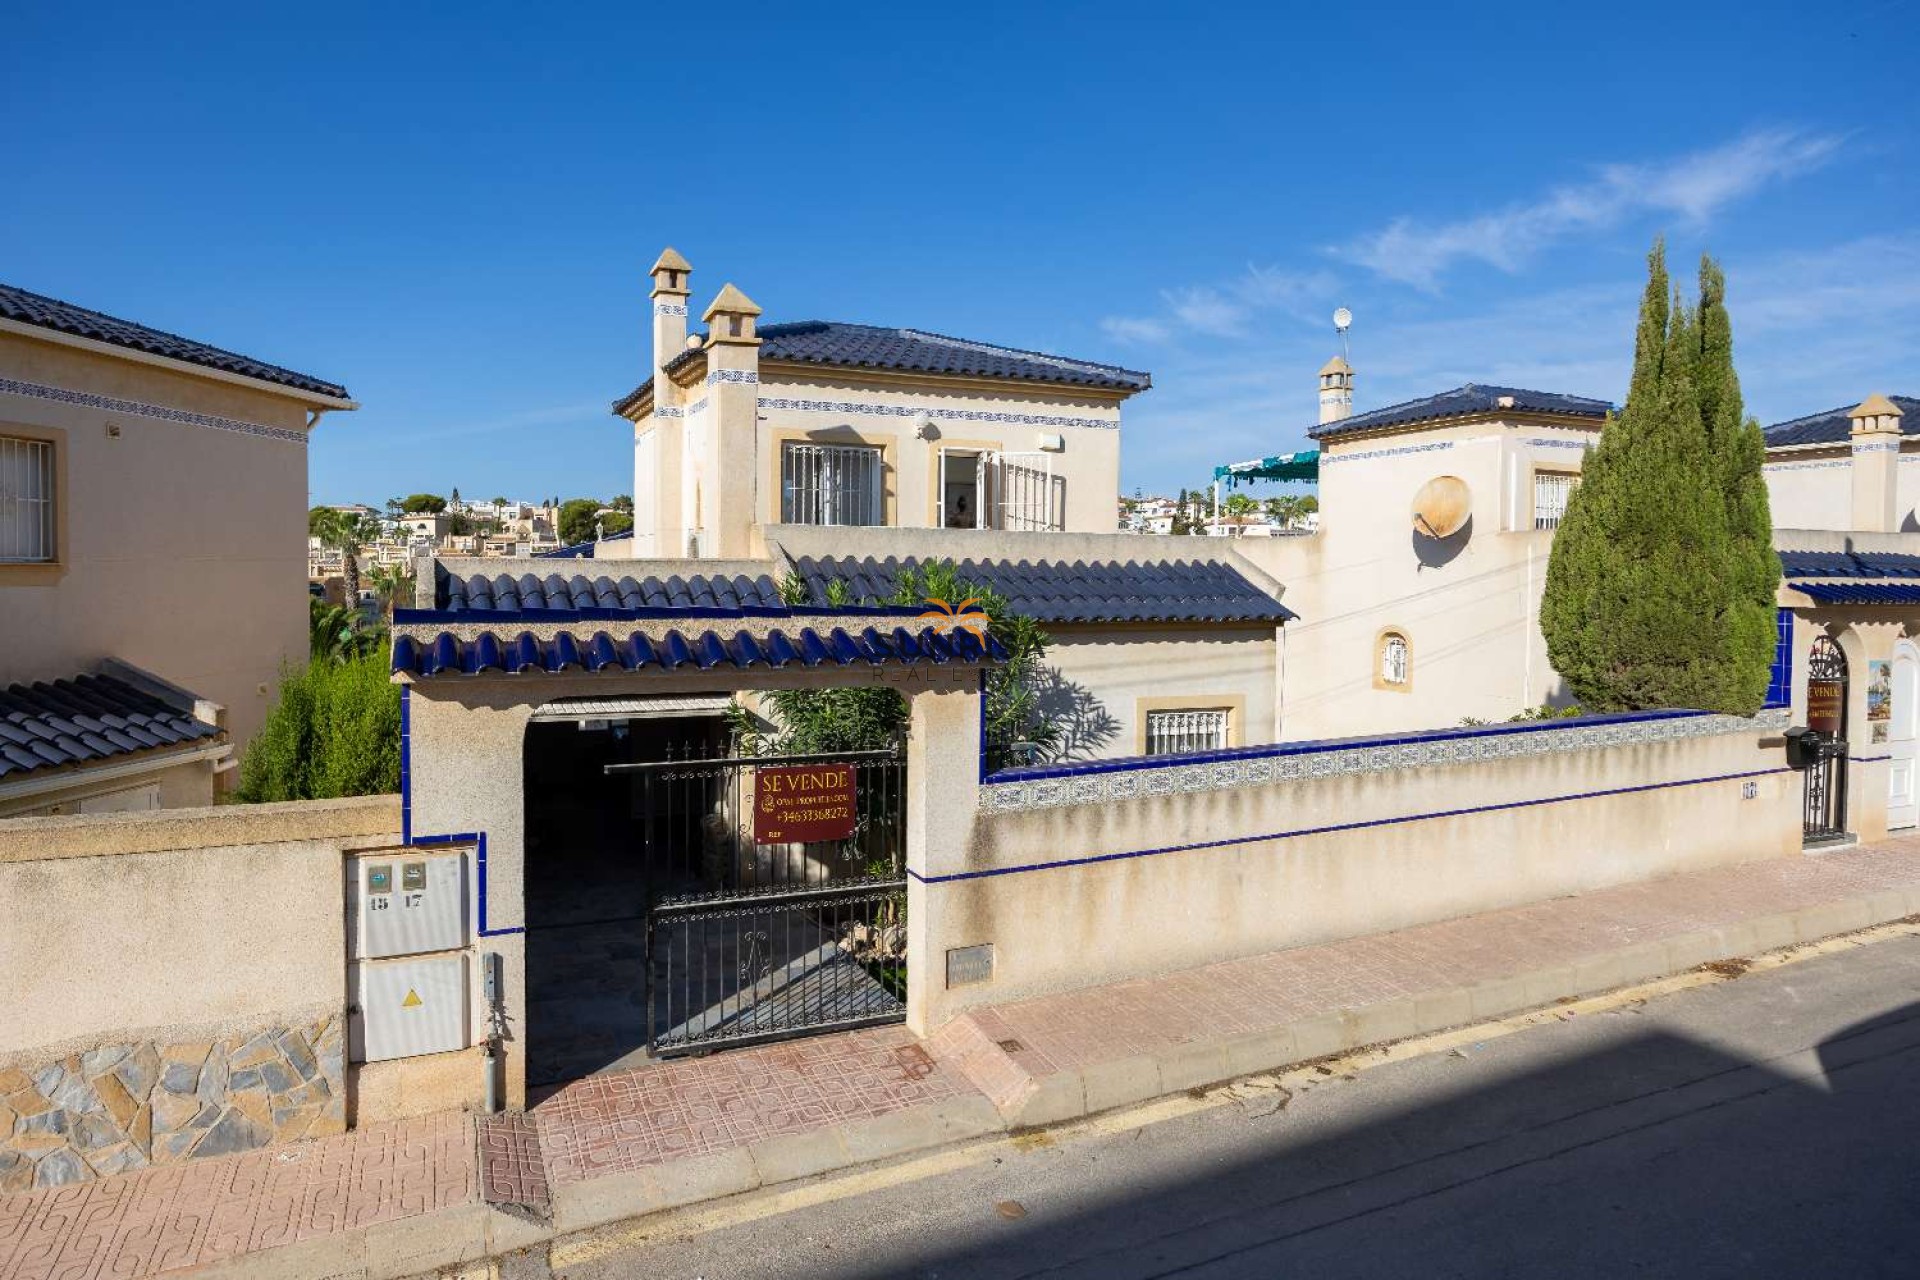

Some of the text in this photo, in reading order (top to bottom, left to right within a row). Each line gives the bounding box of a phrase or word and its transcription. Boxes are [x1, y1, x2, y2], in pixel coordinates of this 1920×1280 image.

[762, 771, 848, 793] SE VENDE
[405, 894, 423, 908] 17
